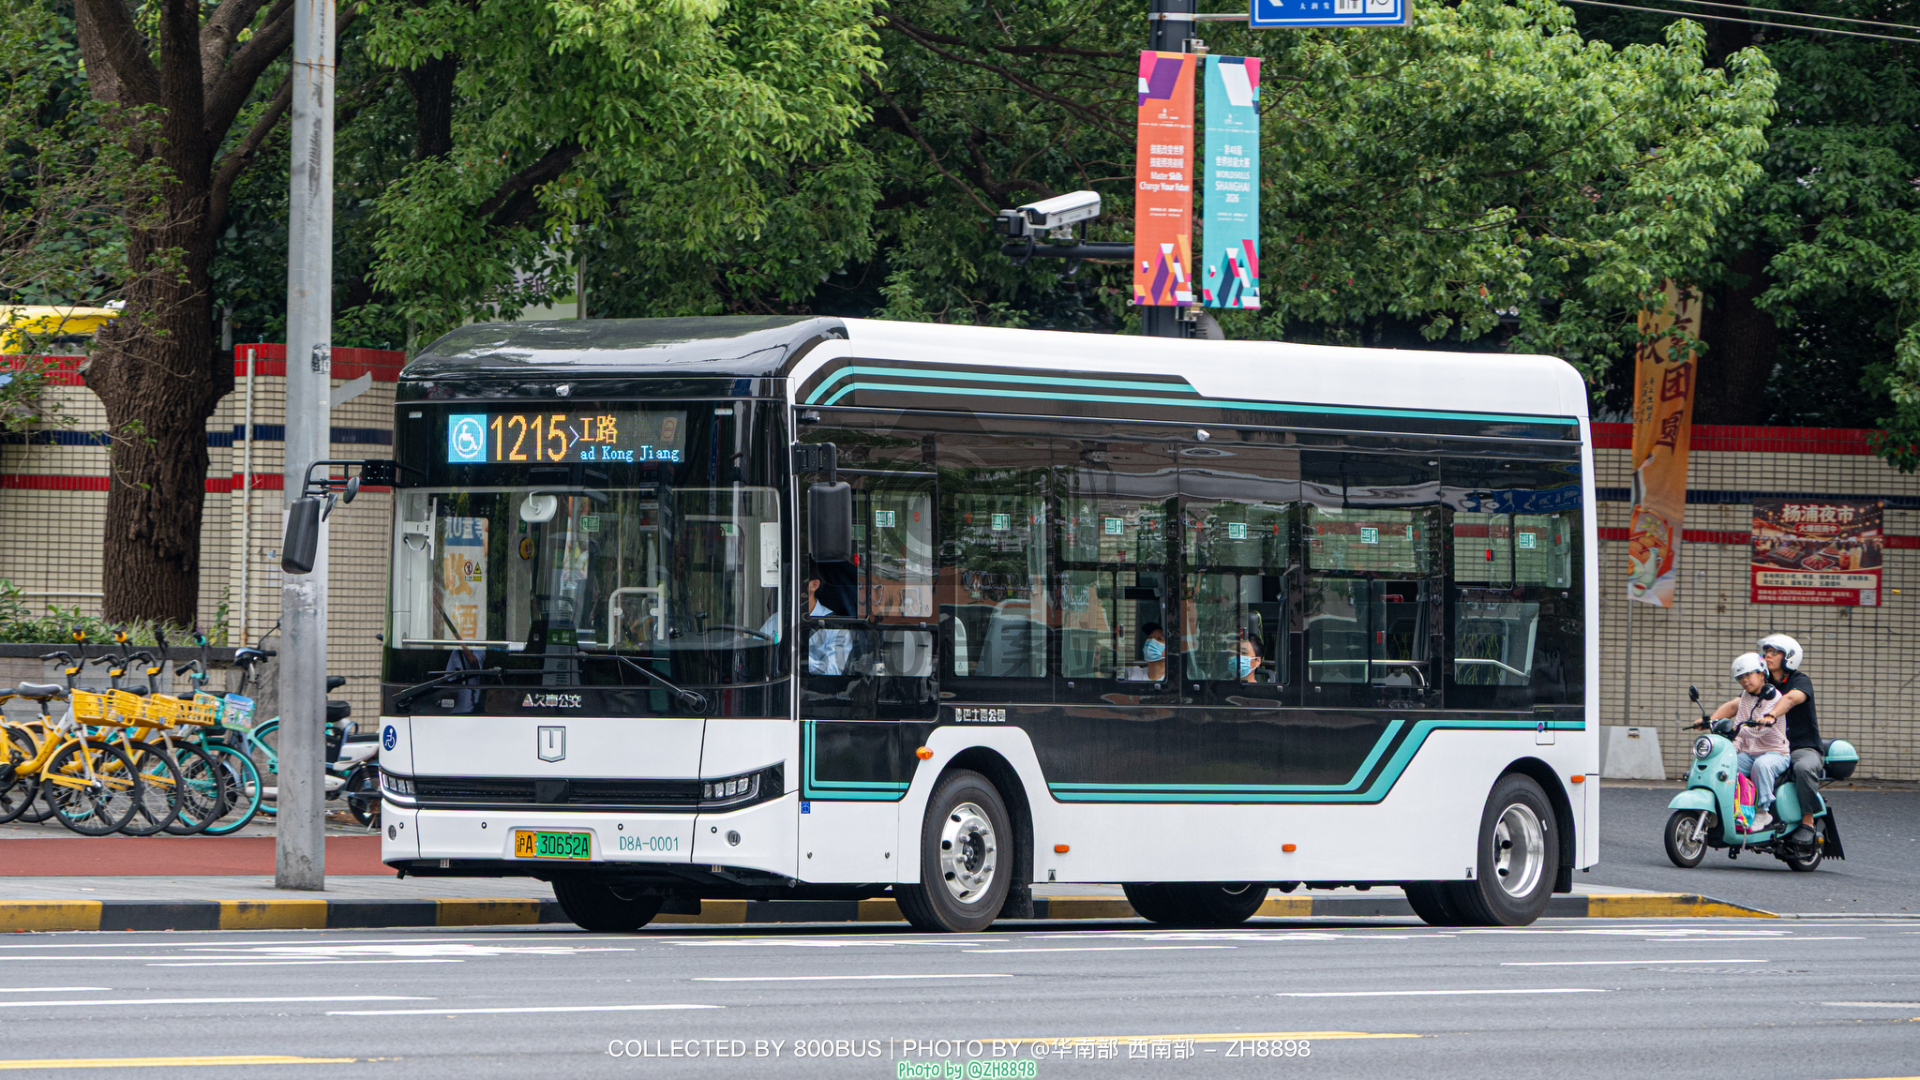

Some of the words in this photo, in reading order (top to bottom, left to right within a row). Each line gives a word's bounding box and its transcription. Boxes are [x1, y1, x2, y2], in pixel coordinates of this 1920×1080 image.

[1215, 181, 1250, 192] SHANGHAI
[490, 414, 567, 462] 1215
[579, 447, 596, 461] ad
[601, 446, 634, 463] Kong
[639, 445, 680, 462] Jiang
[1782, 503, 1855, 523] 杨浦夜市
[540, 835, 589, 857] 30652A
[619, 836, 679, 852] D8A-0001
